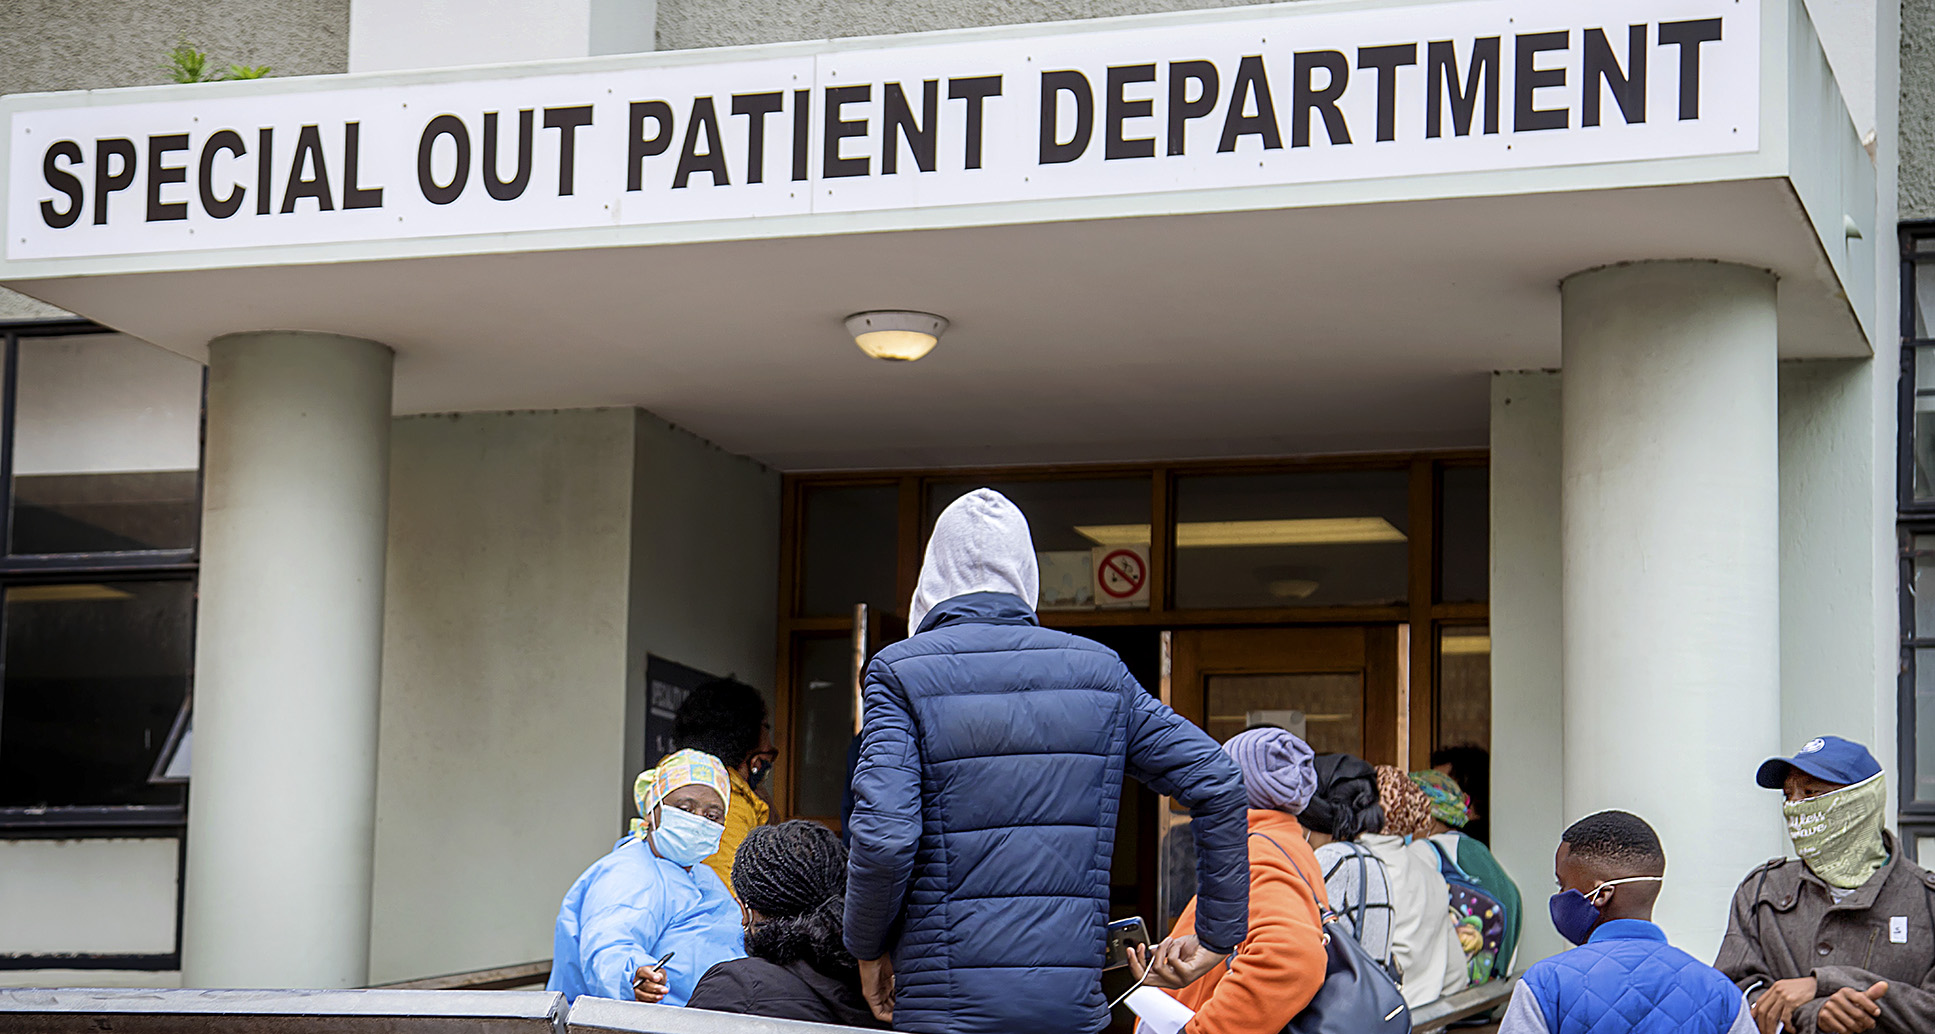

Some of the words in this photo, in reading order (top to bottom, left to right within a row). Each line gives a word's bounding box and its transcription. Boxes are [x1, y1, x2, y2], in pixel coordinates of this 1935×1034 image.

[39, 122, 384, 229] SPECIAL
[417, 105, 594, 206] OUT
[626, 75, 1003, 193] PATIENT
[1038, 17, 1723, 166] DEPARTMENT
